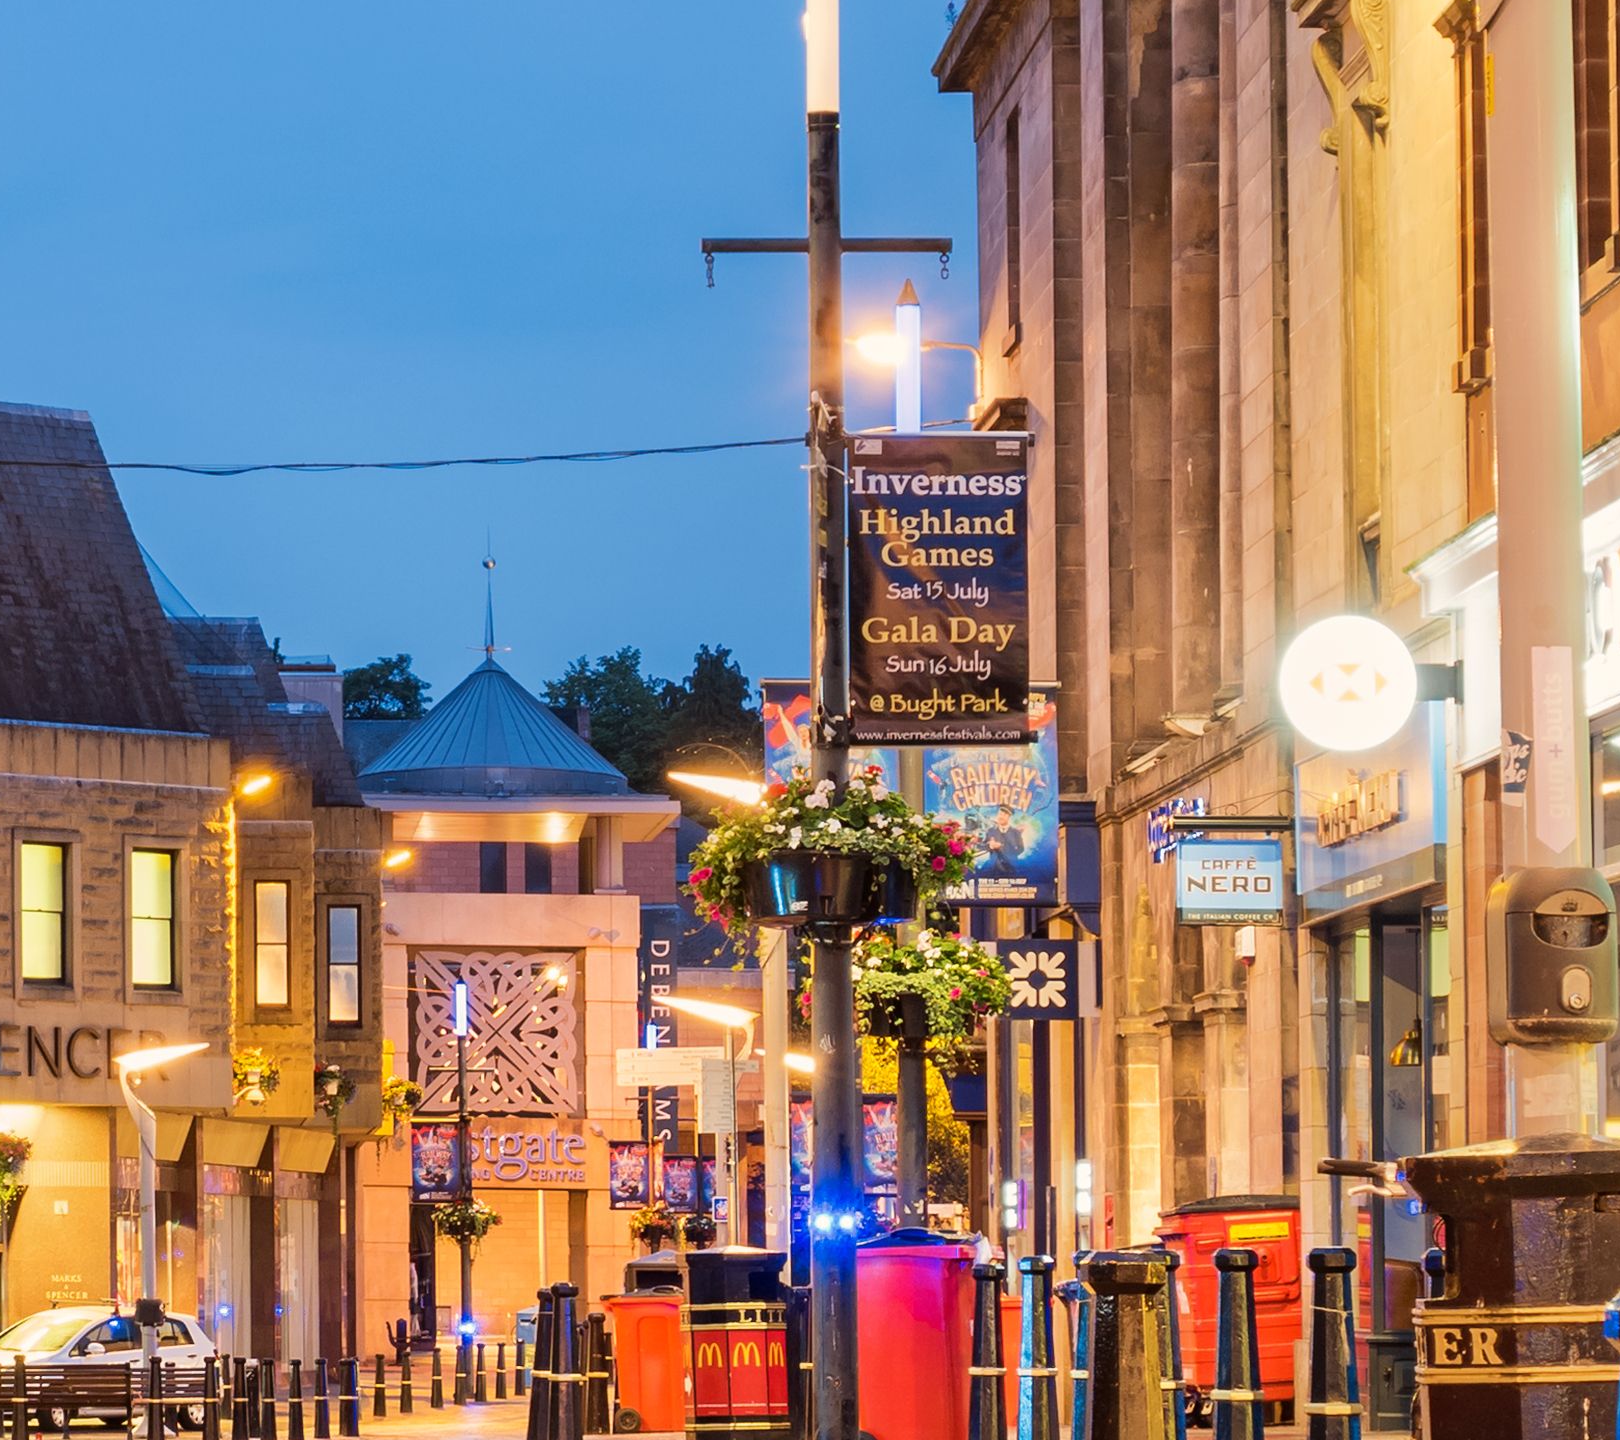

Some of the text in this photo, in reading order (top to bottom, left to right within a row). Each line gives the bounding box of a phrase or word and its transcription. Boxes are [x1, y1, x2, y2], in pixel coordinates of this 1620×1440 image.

[852, 466, 1021, 496] Inverness
[860, 509, 1016, 541] Highland
[881, 541, 994, 567] Games
[886, 577, 989, 608] Sat 15 July
[862, 617, 1016, 652] Gala Day
[885, 650, 991, 681] Sun 16 July
[869, 695, 885, 713] @
[890, 688, 956, 720] Bught
[960, 688, 1008, 714] Park
[856, 725, 1020, 741] www.invernessfestivals.com
[951, 764, 1038, 787] RAILWAY
[953, 787, 1032, 812] CHILDREN
[1202, 856, 1256, 870] CAFFÈ
[1187, 876, 1271, 893] NERO
[1188, 913, 1263, 921] THE ITALIAN COFFEE
[650, 939, 672, 1142] DEBENMS
[471, 1125, 586, 1182] stgate
[529, 1168, 586, 1182] CENTRE
[51, 1274, 82, 1283] MARKS
[45, 1291, 88, 1300] SPENCER
